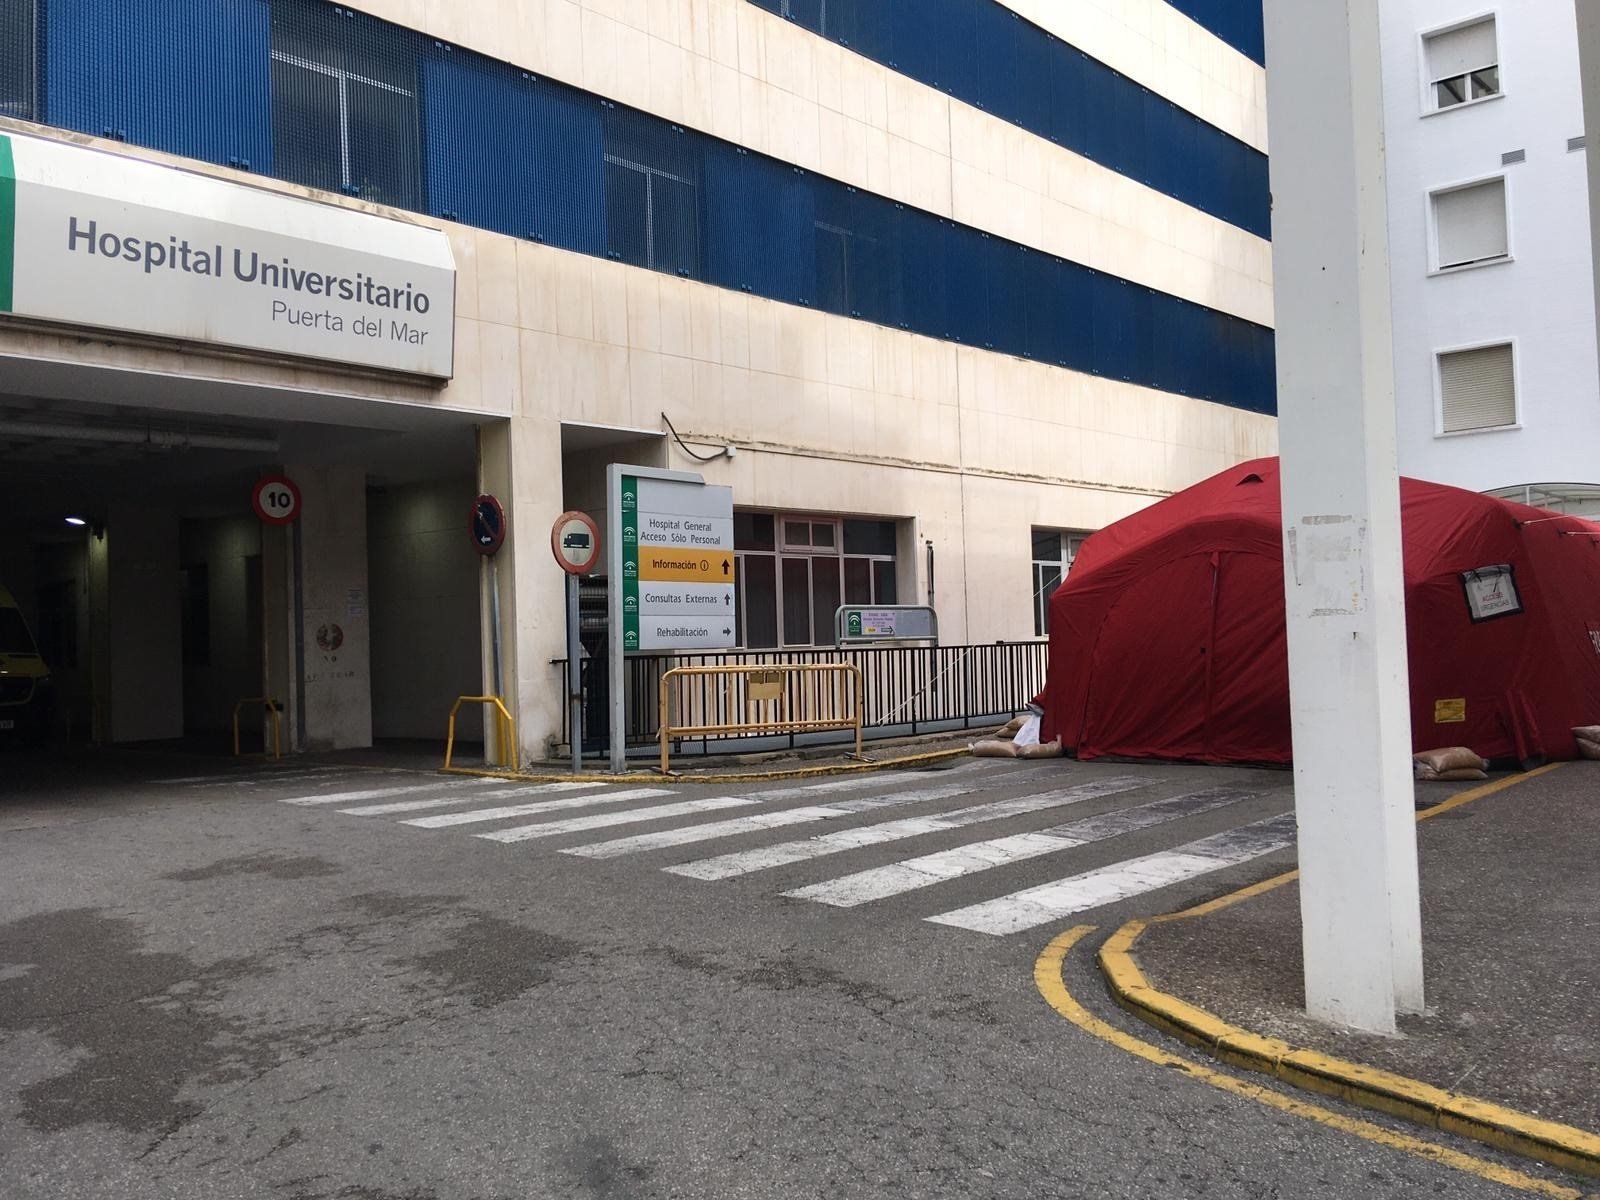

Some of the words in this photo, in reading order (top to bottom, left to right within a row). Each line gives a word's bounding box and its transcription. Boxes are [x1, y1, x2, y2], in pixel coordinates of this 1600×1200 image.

[68, 217, 222, 277] Hospital
[233, 248, 431, 314] Universitario
[271, 300, 344, 333] Puerta
[352, 315, 382, 339] del
[390, 321, 430, 346] Mar
[268, 492, 290, 508] 10
[649, 518, 680, 530] Hospital
[684, 521, 712, 531] General
[640, 532, 667, 542] Acceso
[671, 533, 687, 543] Sólo
[691, 535, 721, 545] Personal
[652, 559, 697, 570] Información
[645, 593, 681, 603] Consultas
[685, 595, 717, 604] Externas
[656, 626, 708, 637] Rehabilitación
